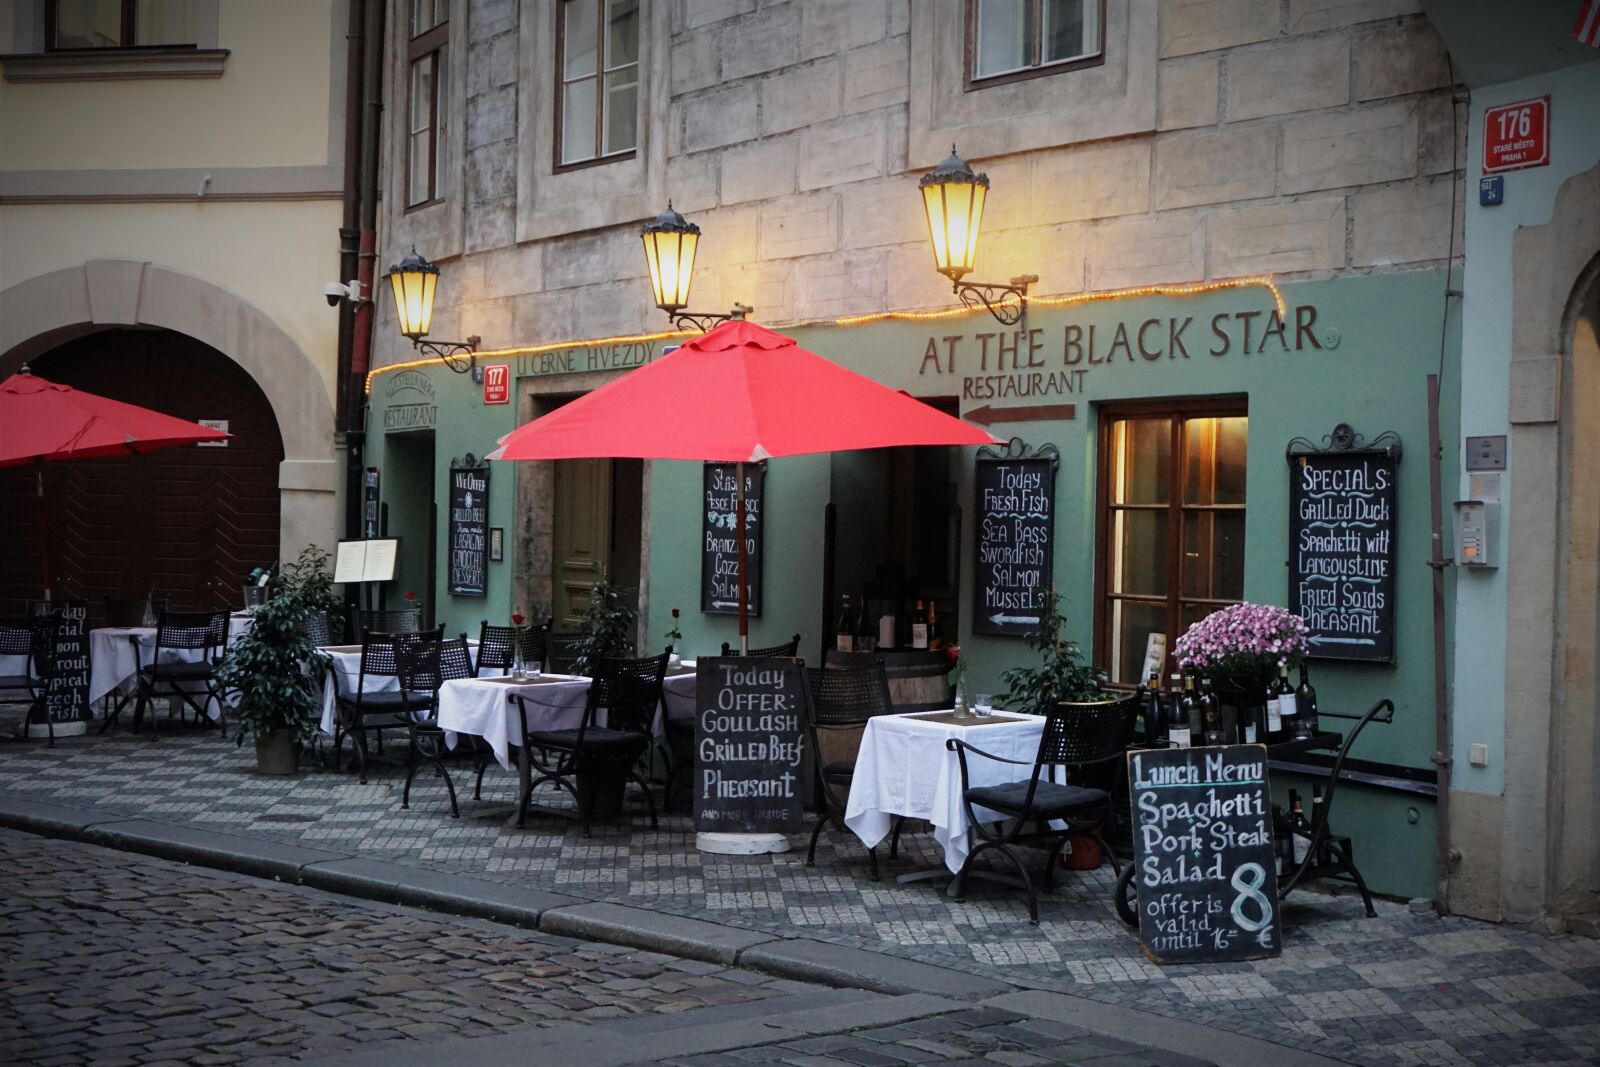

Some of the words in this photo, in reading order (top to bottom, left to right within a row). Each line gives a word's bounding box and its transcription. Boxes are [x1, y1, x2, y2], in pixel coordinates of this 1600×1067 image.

[1498, 108, 1531, 140] 176
[1501, 153, 1522, 162] PRAHA
[919, 335, 963, 374] AT
[975, 328, 1044, 371] THE
[1064, 317, 1193, 365] BLACK
[1210, 304, 1322, 357] STAR
[488, 368, 503, 385] 177
[963, 370, 1088, 399] RESTAURANT
[384, 406, 439, 428] RESTAURANT
[982, 518, 1007, 542] SEA
[1015, 519, 1048, 543] BASS
[56, 654, 89, 670] rout
[719, 664, 785, 690] Today
[46, 688, 83, 705] zech
[718, 688, 795, 711] OFFER:
[1133, 752, 1200, 785] Lunch
[1204, 753, 1263, 783] Menu
[1138, 788, 1266, 829] Spaghetti
[1140, 824, 1203, 854] Pork
[1210, 819, 1271, 851] Steak
[1143, 853, 1226, 887] Salad
[1147, 893, 1203, 916] offer
[1207, 895, 1223, 914] is
[1231, 862, 1273, 932] 8
[1154, 914, 1212, 933] valid
[1152, 931, 1203, 951] until
[1256, 925, 1274, 949] €
